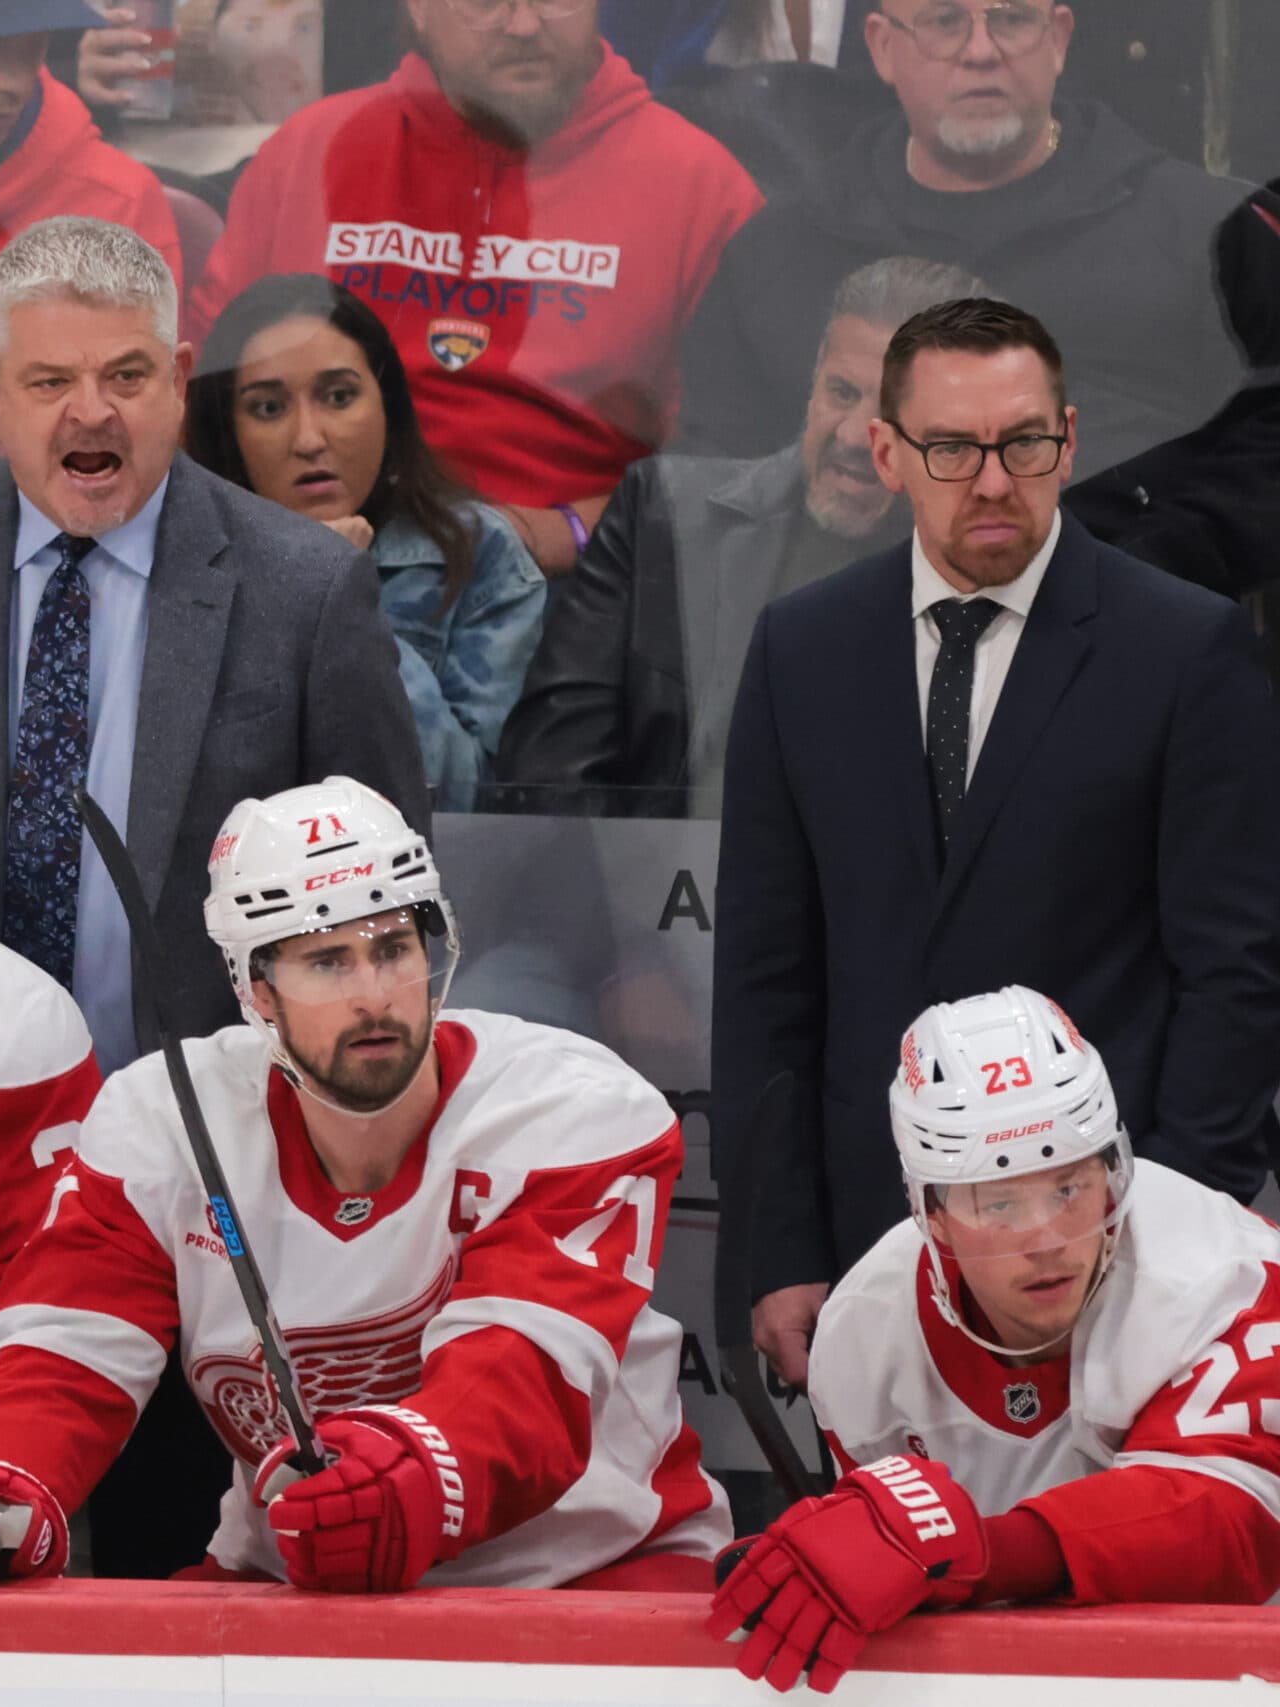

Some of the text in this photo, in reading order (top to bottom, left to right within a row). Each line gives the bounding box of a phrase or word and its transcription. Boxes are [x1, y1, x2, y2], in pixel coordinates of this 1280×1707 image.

[334, 227, 613, 280] STANLEY CUP
[341, 263, 590, 322] PLAYOFFS
[297, 813, 347, 845] 71
[304, 863, 374, 892] CCM
[980, 1056, 1033, 1096] 23
[553, 1174, 658, 1292] 71
[855, 1455, 957, 1543] RIOR
